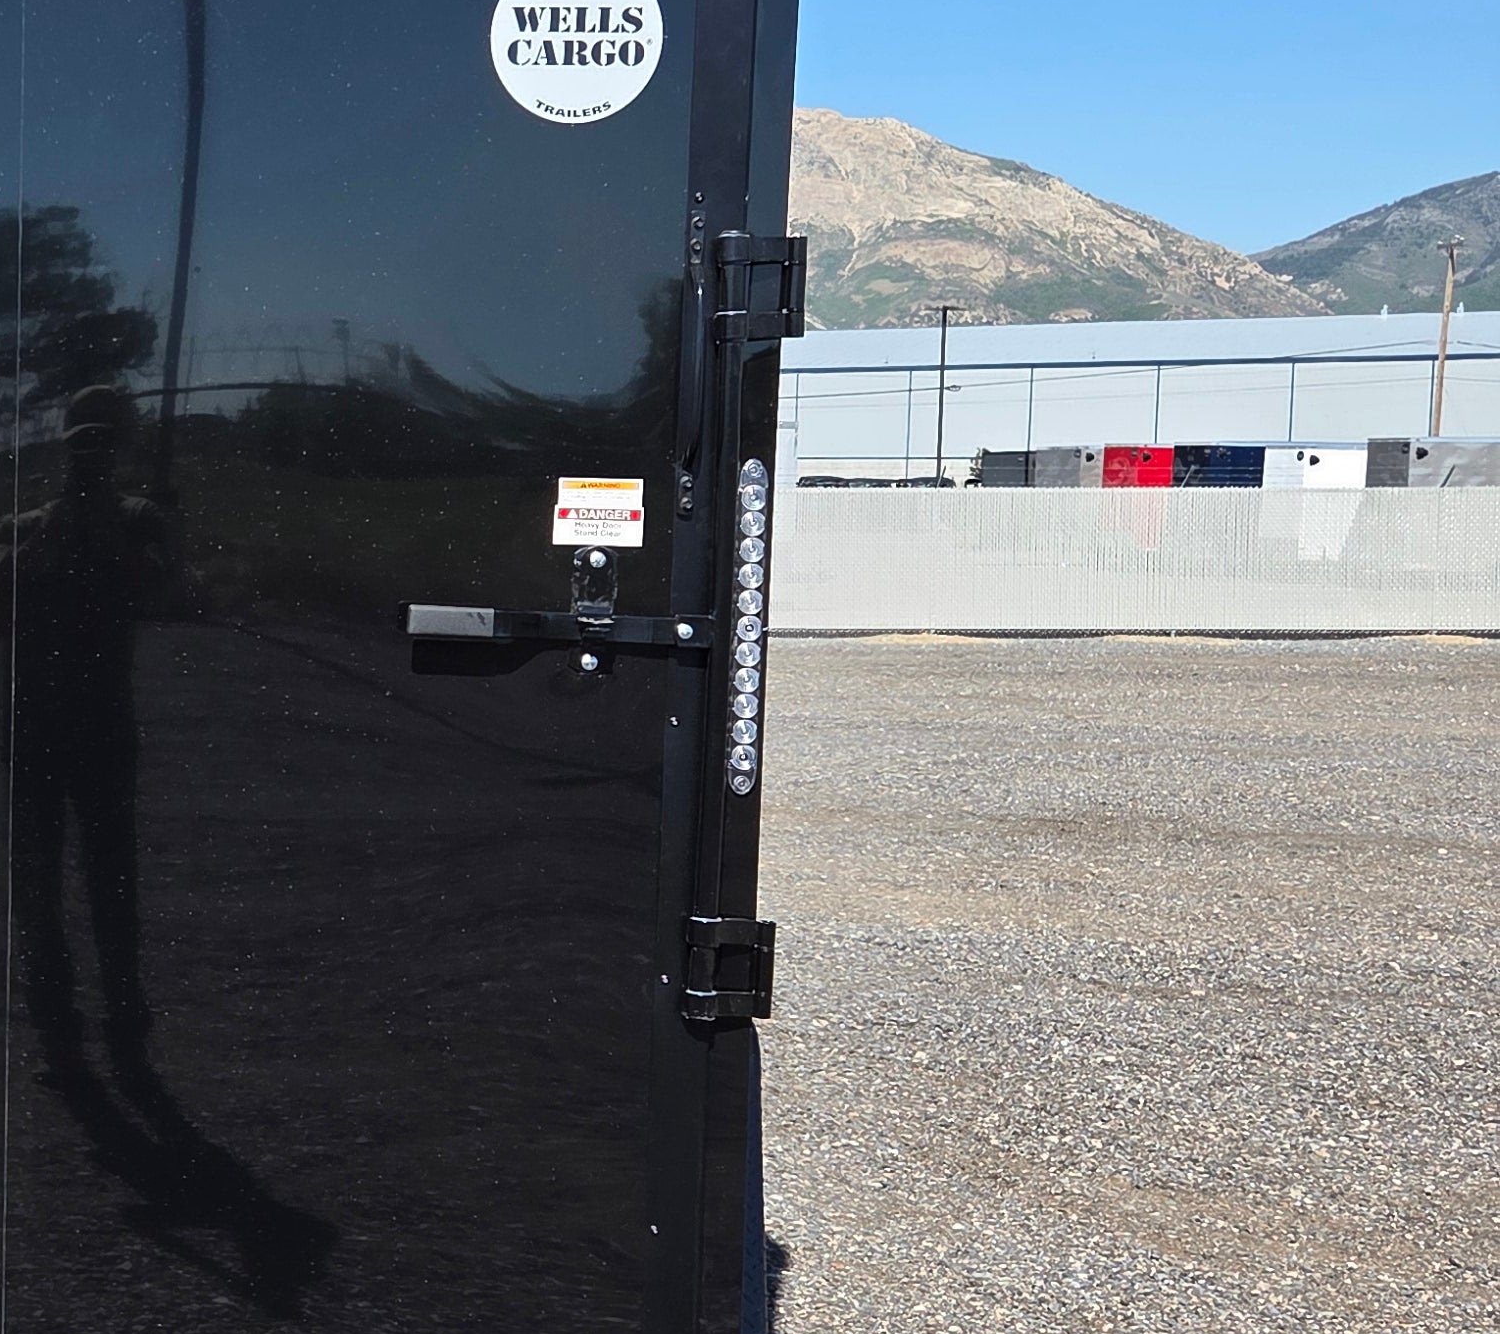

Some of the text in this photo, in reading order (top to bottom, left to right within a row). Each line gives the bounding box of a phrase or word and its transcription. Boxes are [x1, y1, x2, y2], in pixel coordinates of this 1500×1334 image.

[511, 6, 644, 34] WELLS
[507, 38, 646, 67] CARGO
[535, 99, 612, 118] TRAILERS
[578, 509, 631, 521] DANGER
[574, 521, 600, 529] Heavy
[574, 529, 598, 537] Stand
